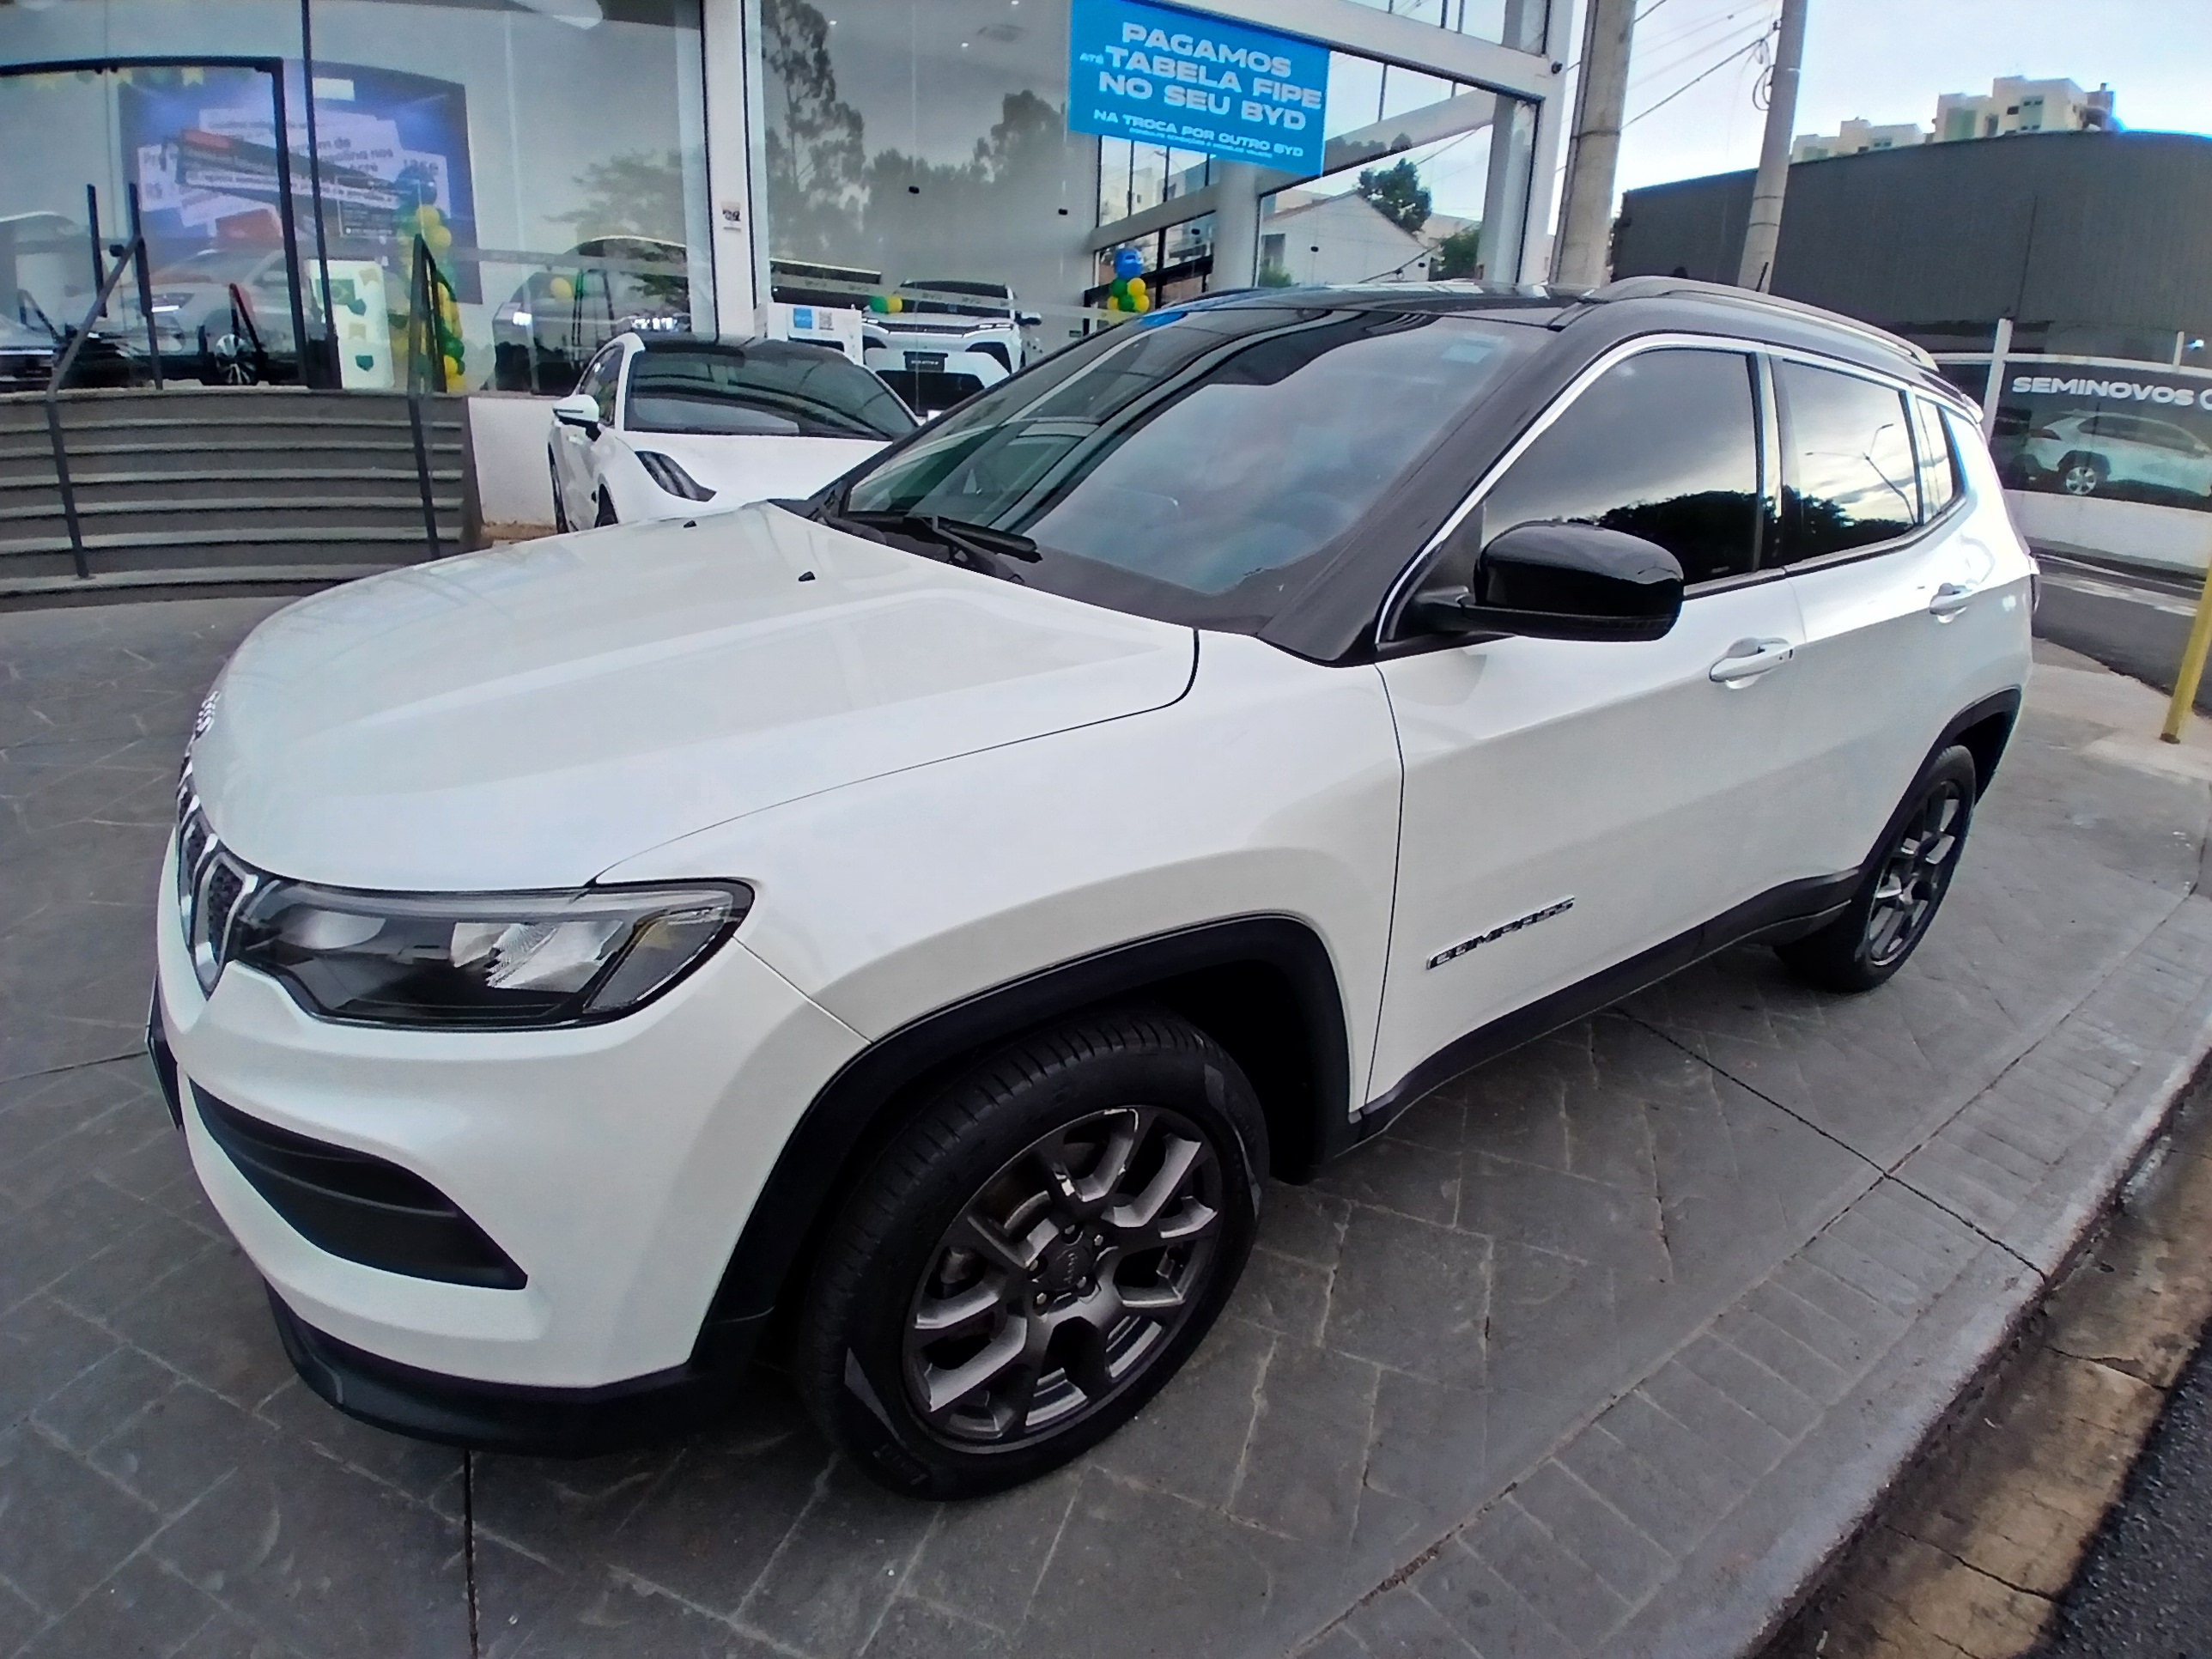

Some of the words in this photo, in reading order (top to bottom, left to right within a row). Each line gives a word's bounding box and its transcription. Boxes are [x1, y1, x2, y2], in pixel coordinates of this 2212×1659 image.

[1104, 45, 1243, 93] TABELA
[1252, 76, 1322, 110] FIPE
[1121, 21, 1291, 78] PAGAMOS
[1099, 71, 1153, 100] NO
[1164, 84, 1231, 115] SEU
[1241, 100, 1306, 130] BYD
[1093, 109, 1118, 123] NA
[1122, 114, 1177, 134] TROCA
[1181, 125, 1215, 140] POR
[1218, 133, 1271, 150] OUTRO
[1273, 143, 1304, 157] BYD
[2012, 376, 2195, 406] SEMINOVOS
